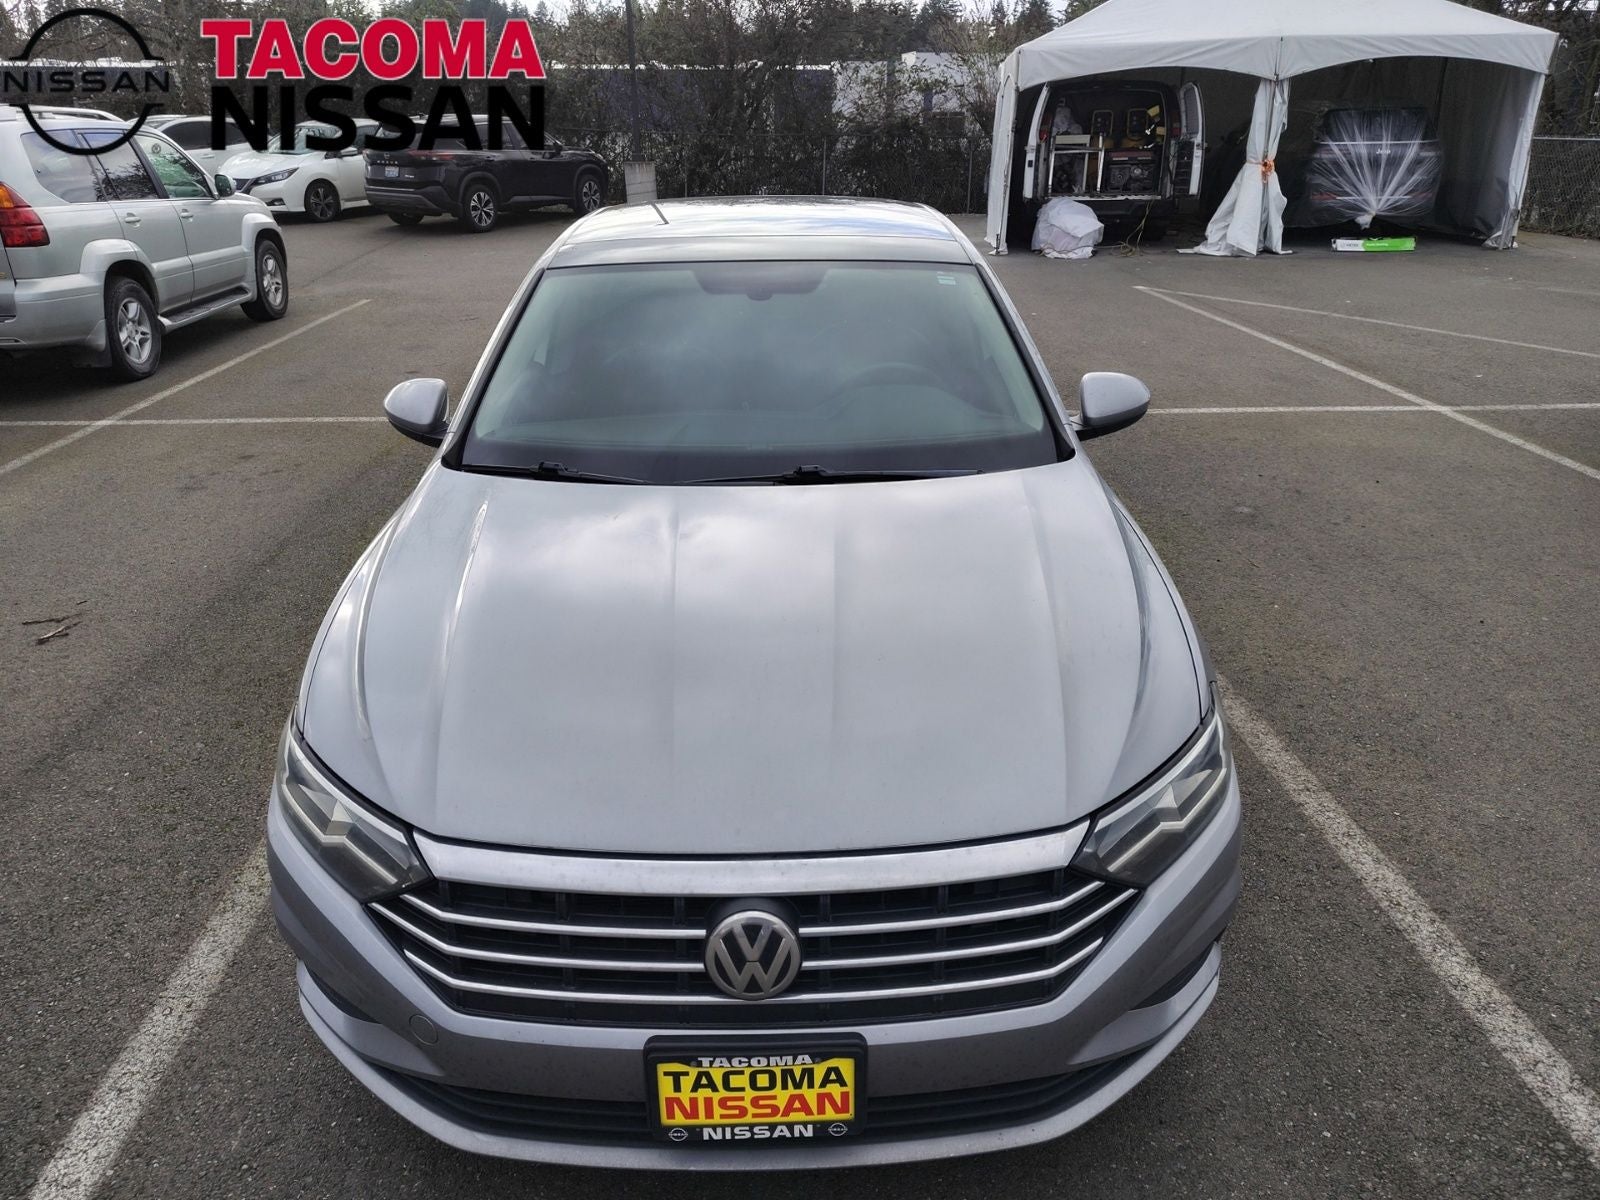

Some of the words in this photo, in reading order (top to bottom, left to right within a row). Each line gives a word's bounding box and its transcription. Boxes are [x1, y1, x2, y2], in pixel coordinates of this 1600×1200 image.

[698, 1054, 814, 1068] TACOMA
[663, 1066, 849, 1093] TACOMA
[664, 1091, 851, 1121] NISSAN
[703, 1124, 814, 1141] NISSAN
